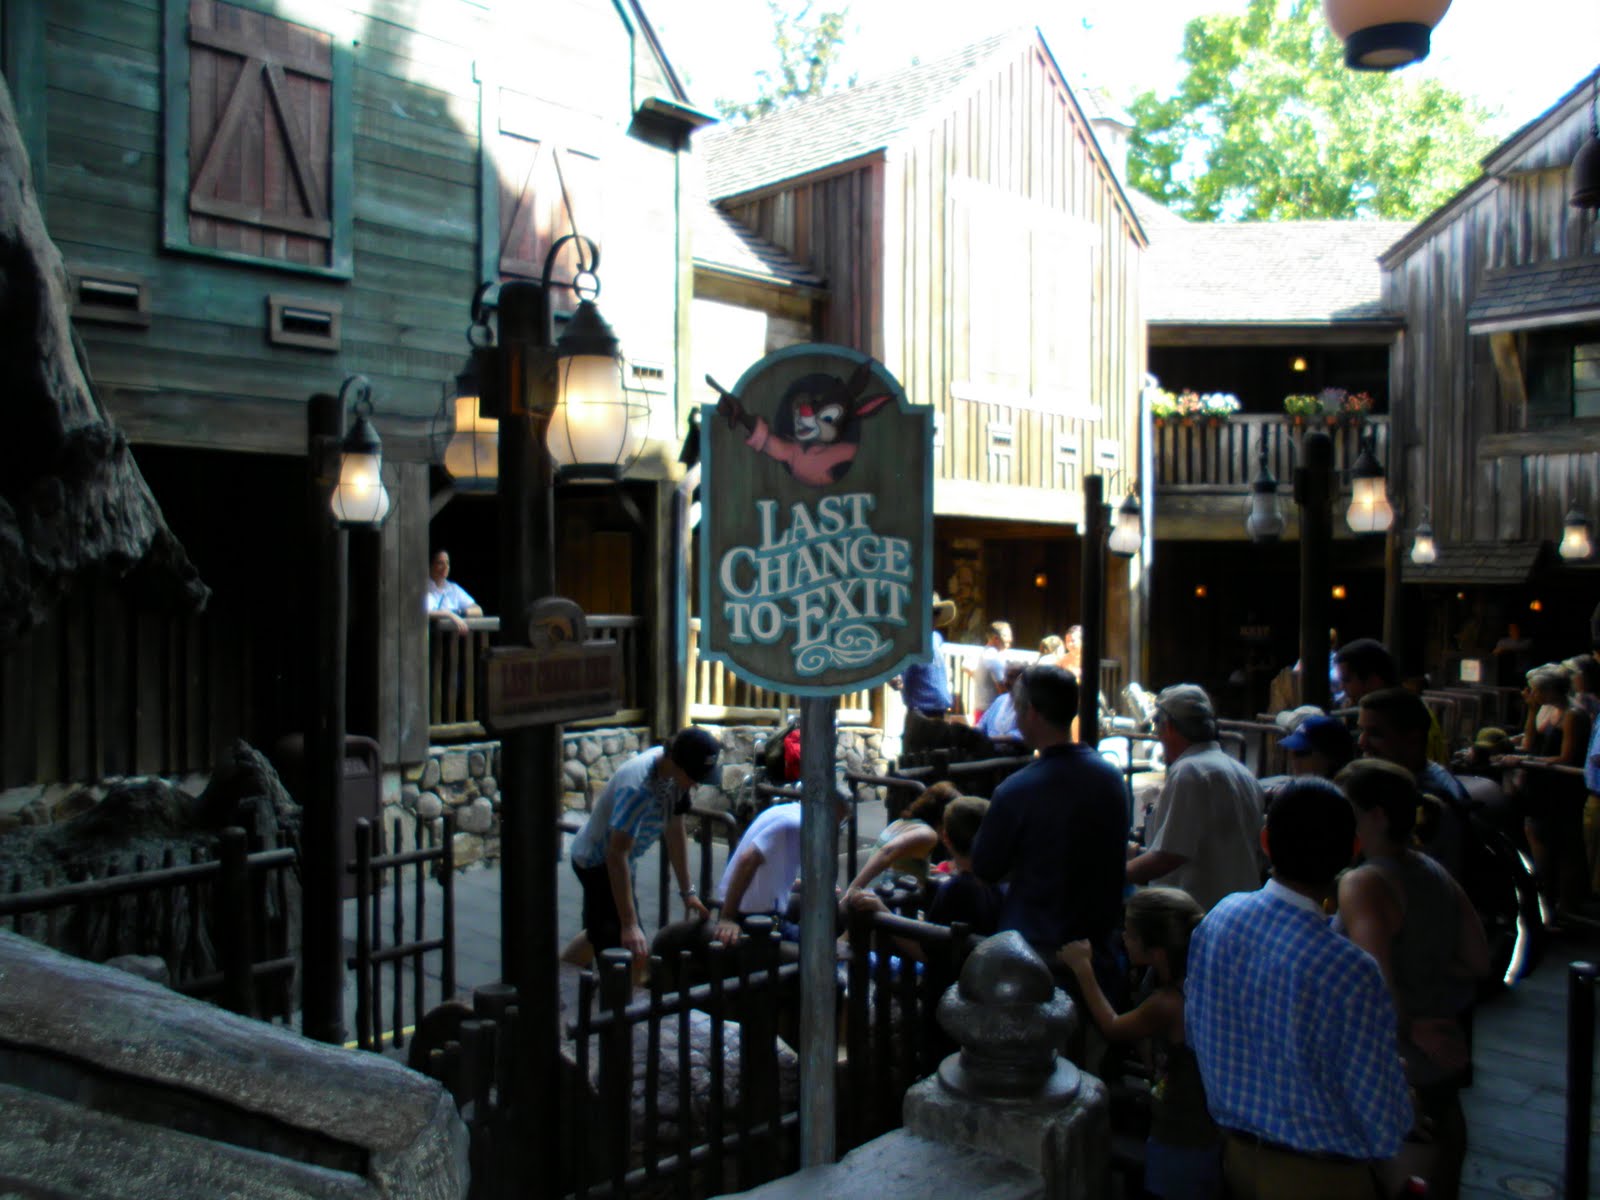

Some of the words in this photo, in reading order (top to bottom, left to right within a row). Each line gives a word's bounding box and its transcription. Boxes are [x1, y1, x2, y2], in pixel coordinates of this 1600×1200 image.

[755, 493, 874, 551] LAST
[720, 534, 910, 599] CHANCE
[724, 601, 782, 639] TO
[783, 577, 908, 650] EXIT
